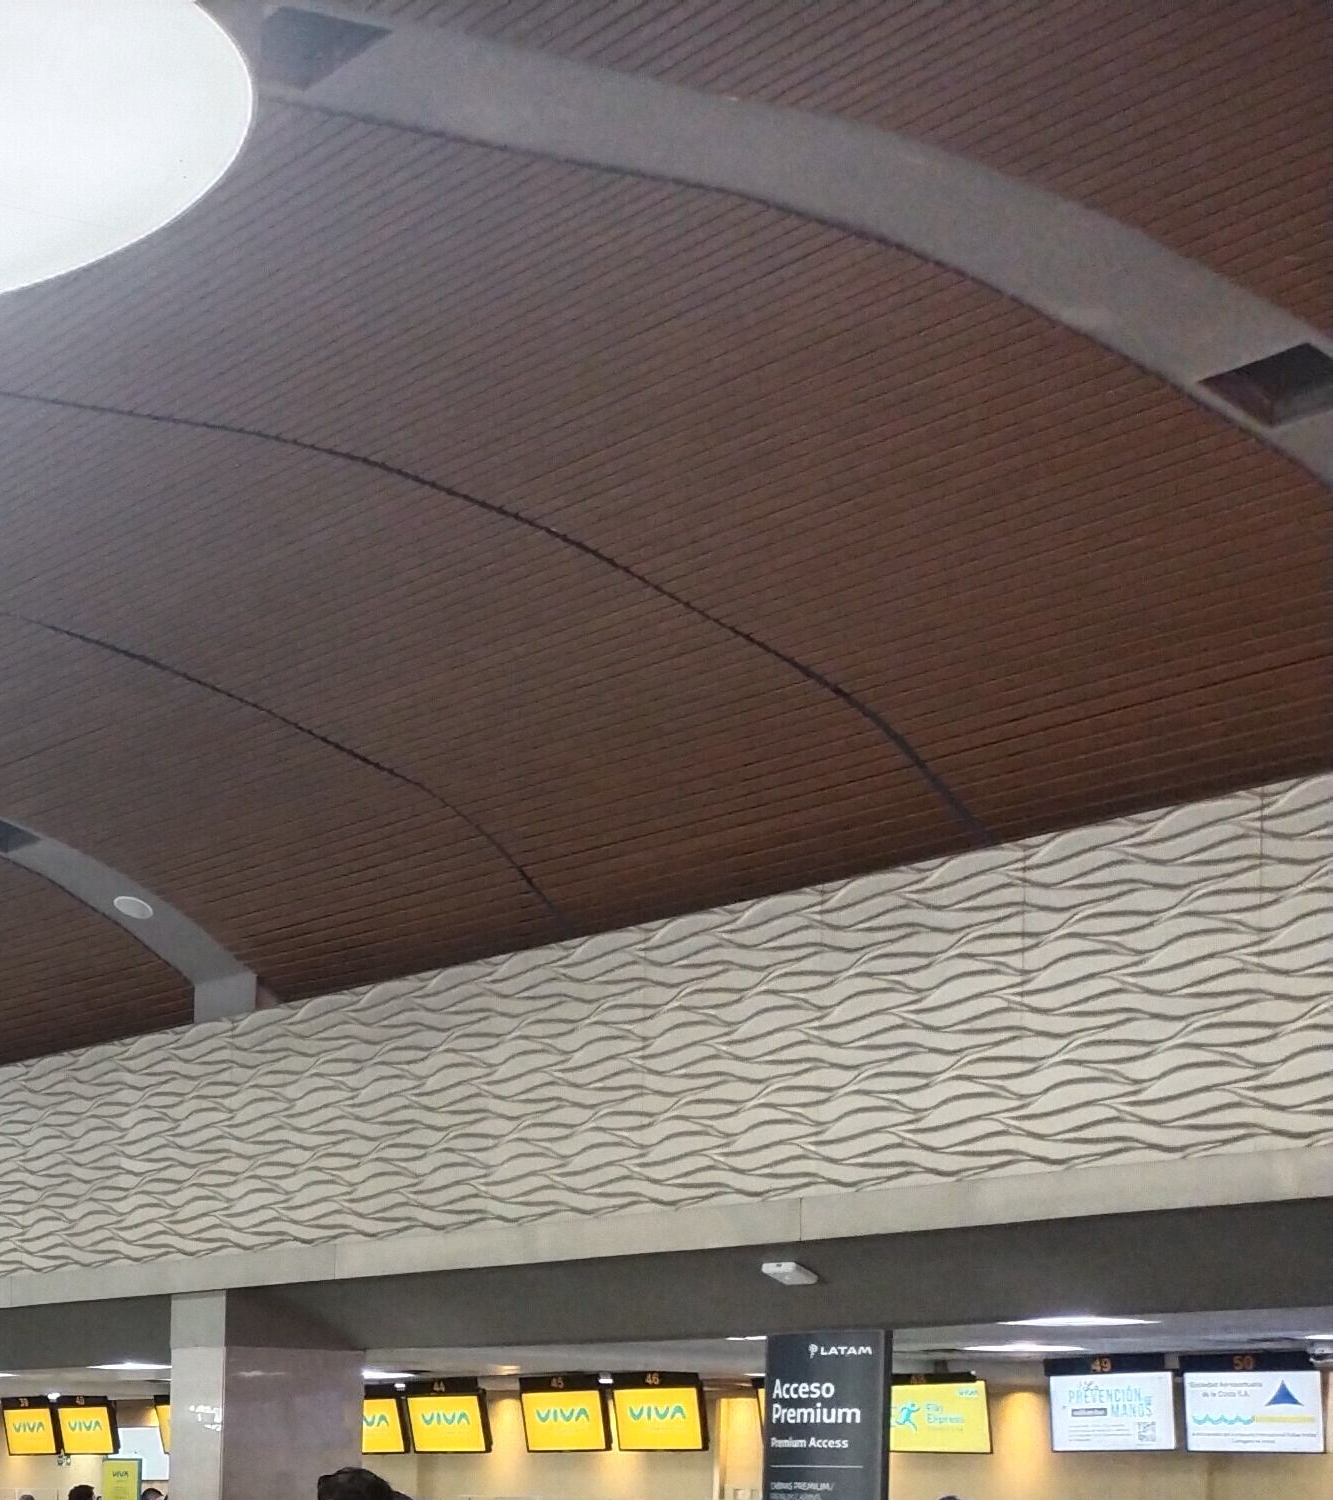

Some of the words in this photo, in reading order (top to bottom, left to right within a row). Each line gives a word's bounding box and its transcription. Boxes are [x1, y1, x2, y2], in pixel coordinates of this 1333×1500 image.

[820, 1346, 873, 1356] LATAM
[1232, 1355, 1254, 1371] 50
[645, 1373, 660, 1385] 46
[773, 1379, 835, 1398] Acceso
[421, 1411, 470, 1425] VIVA
[536, 1408, 590, 1423] VIVA
[628, 1405, 687, 1421] VIVA
[772, 1402, 861, 1424] Premium
[13, 1421, 45, 1433] VIVA
[68, 1421, 103, 1432] VIVA
[770, 1437, 807, 1448] Premium
[809, 1437, 849, 1449] Access
